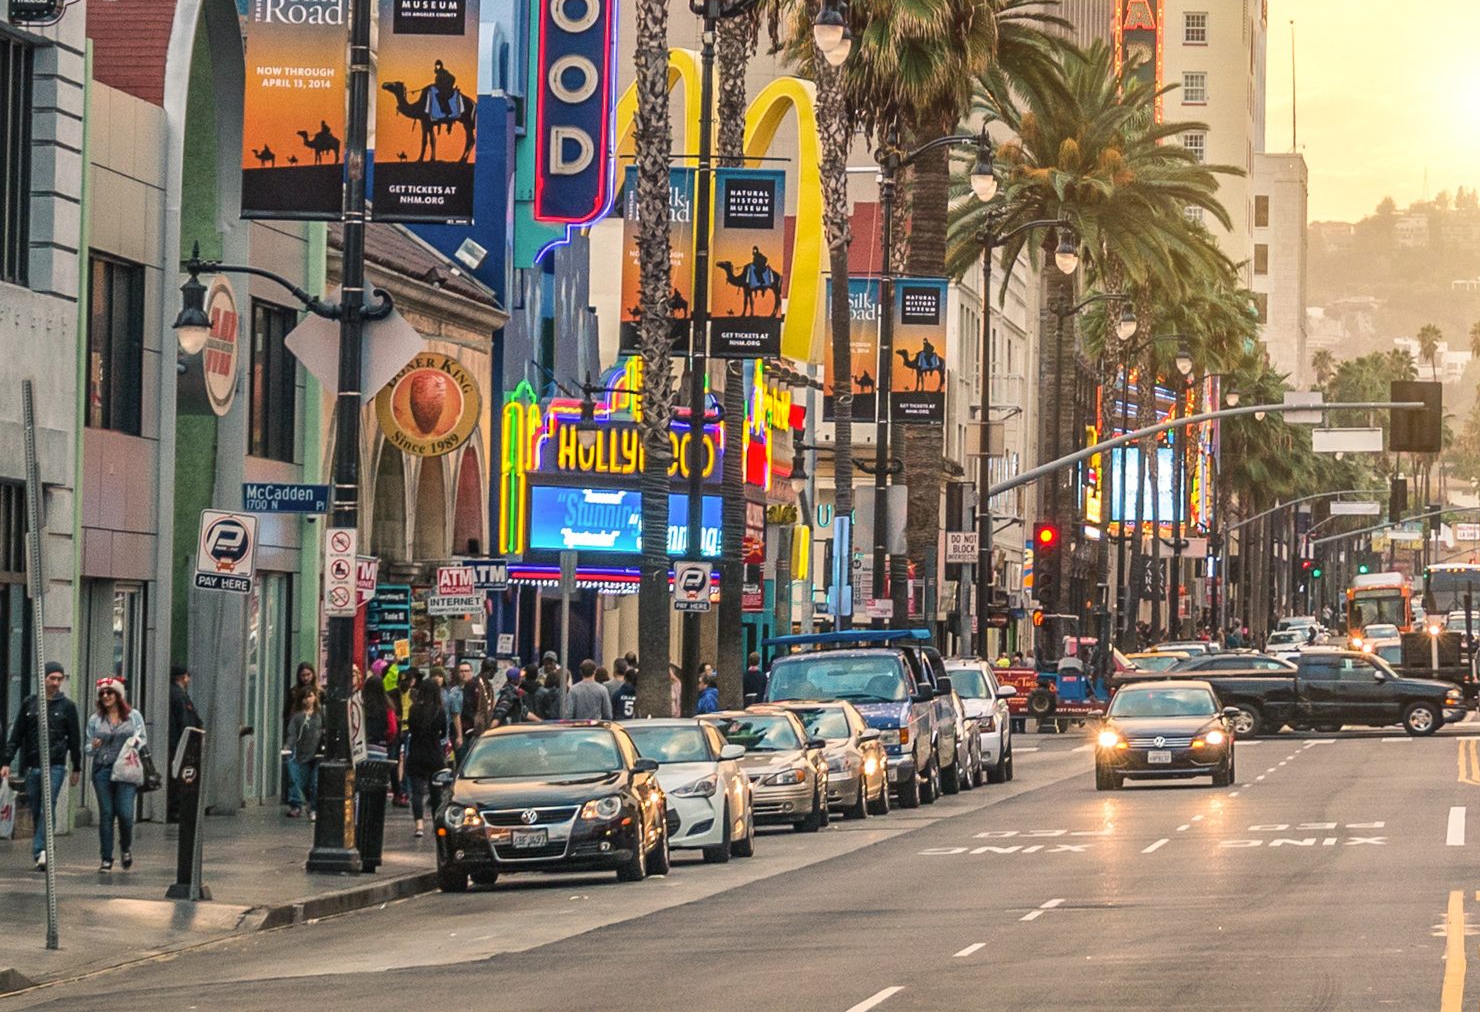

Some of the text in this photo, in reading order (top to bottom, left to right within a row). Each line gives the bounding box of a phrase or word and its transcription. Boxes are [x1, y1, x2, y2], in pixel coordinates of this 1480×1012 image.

[401, 0, 458, 10] MUSEUM
[257, 66, 335, 77] NOW THROUGH
[262, 78, 292, 89] APRIL
[308, 79, 331, 89] 2014
[389, 185, 456, 195] GET TICKETS AT
[399, 195, 444, 205] NHM.ORG
[439, 358, 475, 395] KING
[391, 430, 460, 454] Since 1989
[246, 485, 313, 500] McCadden
[246, 500, 279, 510] 1700 N
[951, 535, 977, 544] DO NOT
[953, 545, 975, 554] BLOCK
[198, 575, 248, 590] PAY HERE
[440, 569, 473, 586] ATM
[430, 597, 481, 606] INTERNET
[675, 602, 709, 610] PAY HERE
[624, 700, 634, 716] 5
